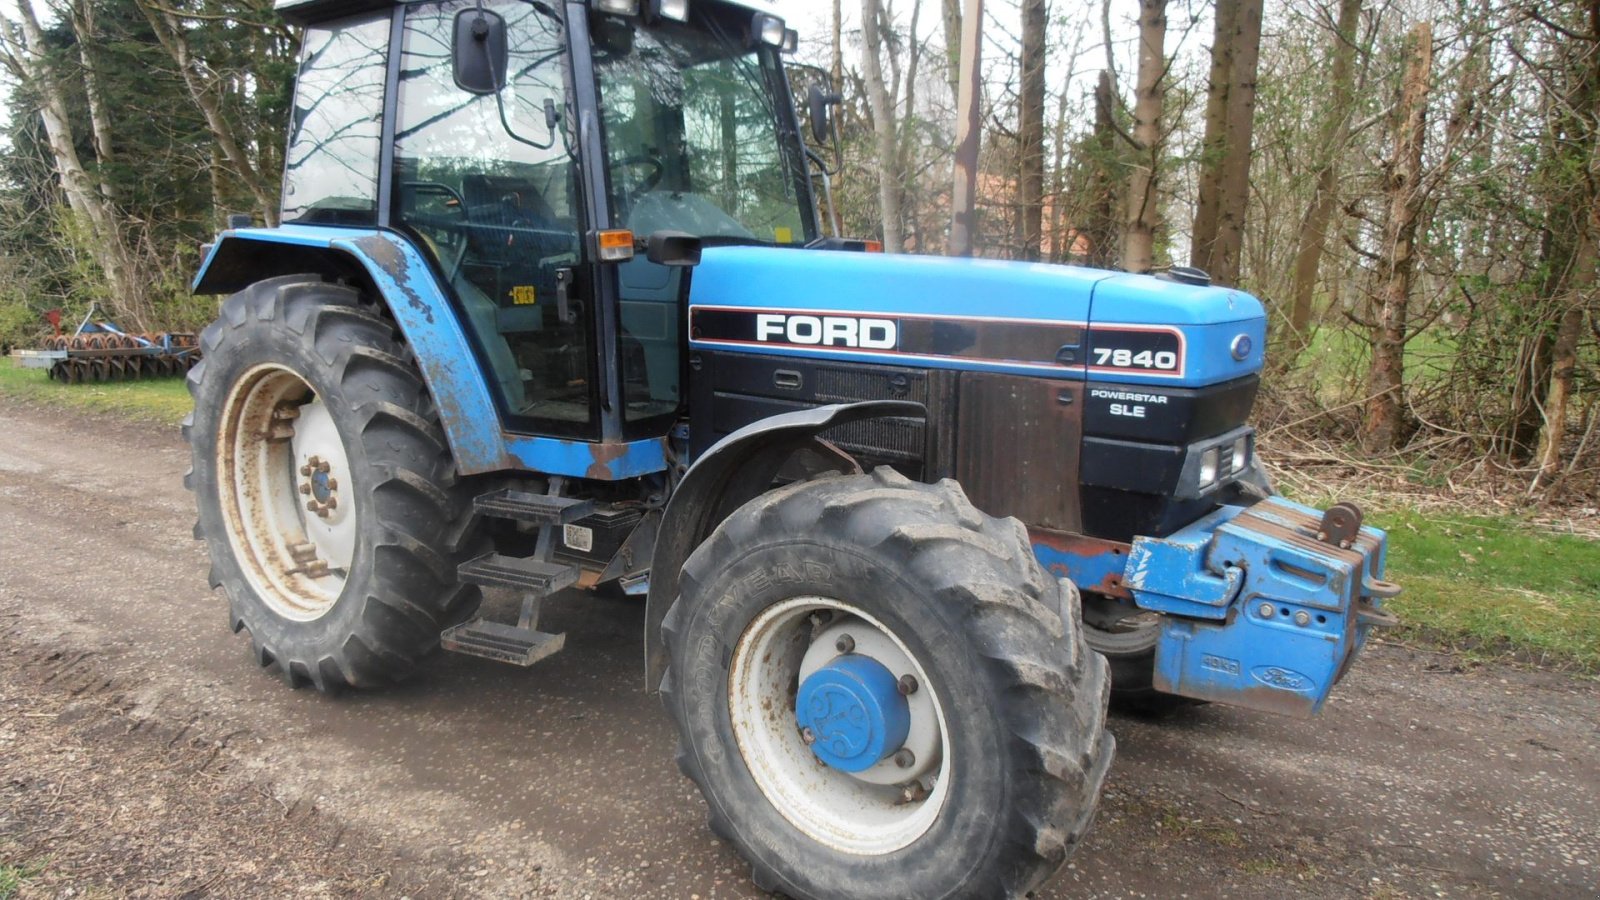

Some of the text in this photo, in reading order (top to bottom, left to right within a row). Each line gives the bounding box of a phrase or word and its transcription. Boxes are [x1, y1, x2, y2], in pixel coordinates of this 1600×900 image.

[757, 314, 897, 350] FORD
[1093, 347, 1177, 370] 7840
[1091, 389, 1168, 404] POWERSTAR
[1109, 403, 1146, 418] SLE
[1263, 666, 1303, 688] Ford
